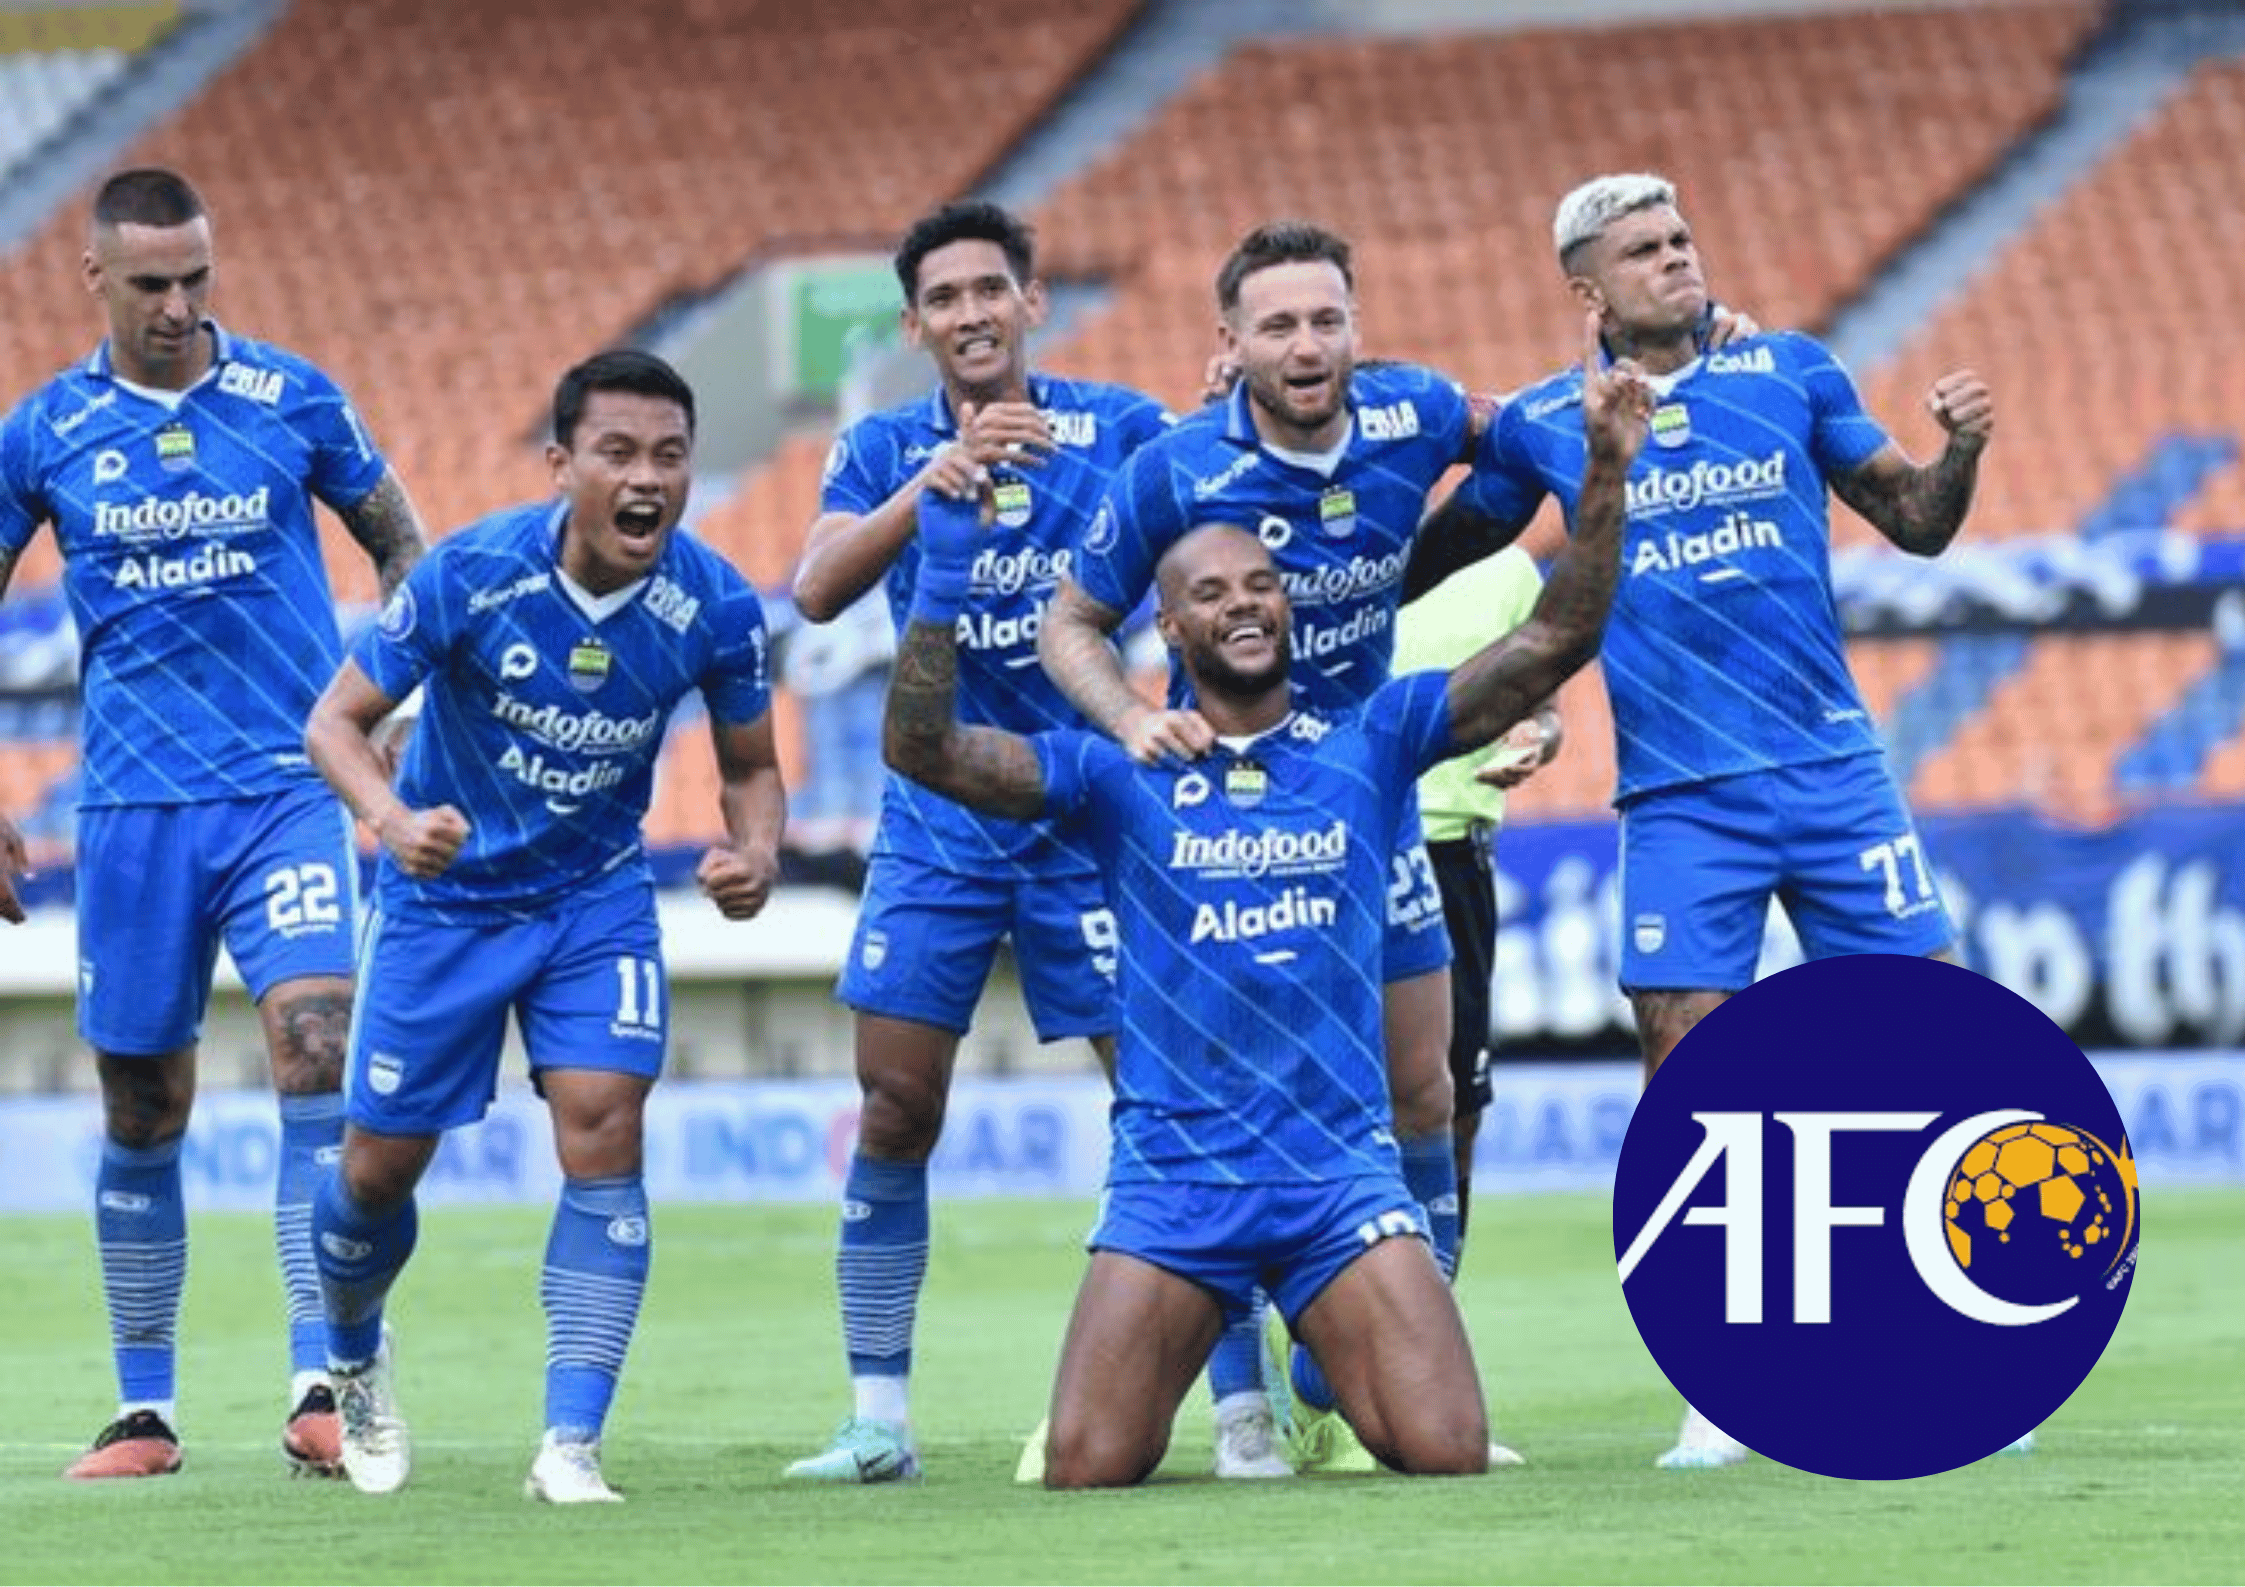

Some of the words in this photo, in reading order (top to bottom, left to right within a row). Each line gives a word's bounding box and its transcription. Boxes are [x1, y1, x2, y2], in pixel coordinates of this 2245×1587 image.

[1624, 449, 1786, 512] dofood
[94, 487, 269, 538] Indofood
[115, 546, 255, 588] Aladin
[972, 546, 1073, 595] dofoo
[1631, 510, 1783, 577] Aladin
[956, 599, 1043, 650] Alad
[490, 691, 659, 752] Indofood
[498, 744, 624, 796] Aladin
[1169, 821, 1347, 877] Indofood
[1859, 834, 1933, 912] 77
[265, 864, 340, 928] 22
[1191, 886, 1337, 943] Aladin
[1386, 845, 1442, 926] 23
[1080, 908, 1117, 973] 9
[617, 955, 660, 1026] 11
